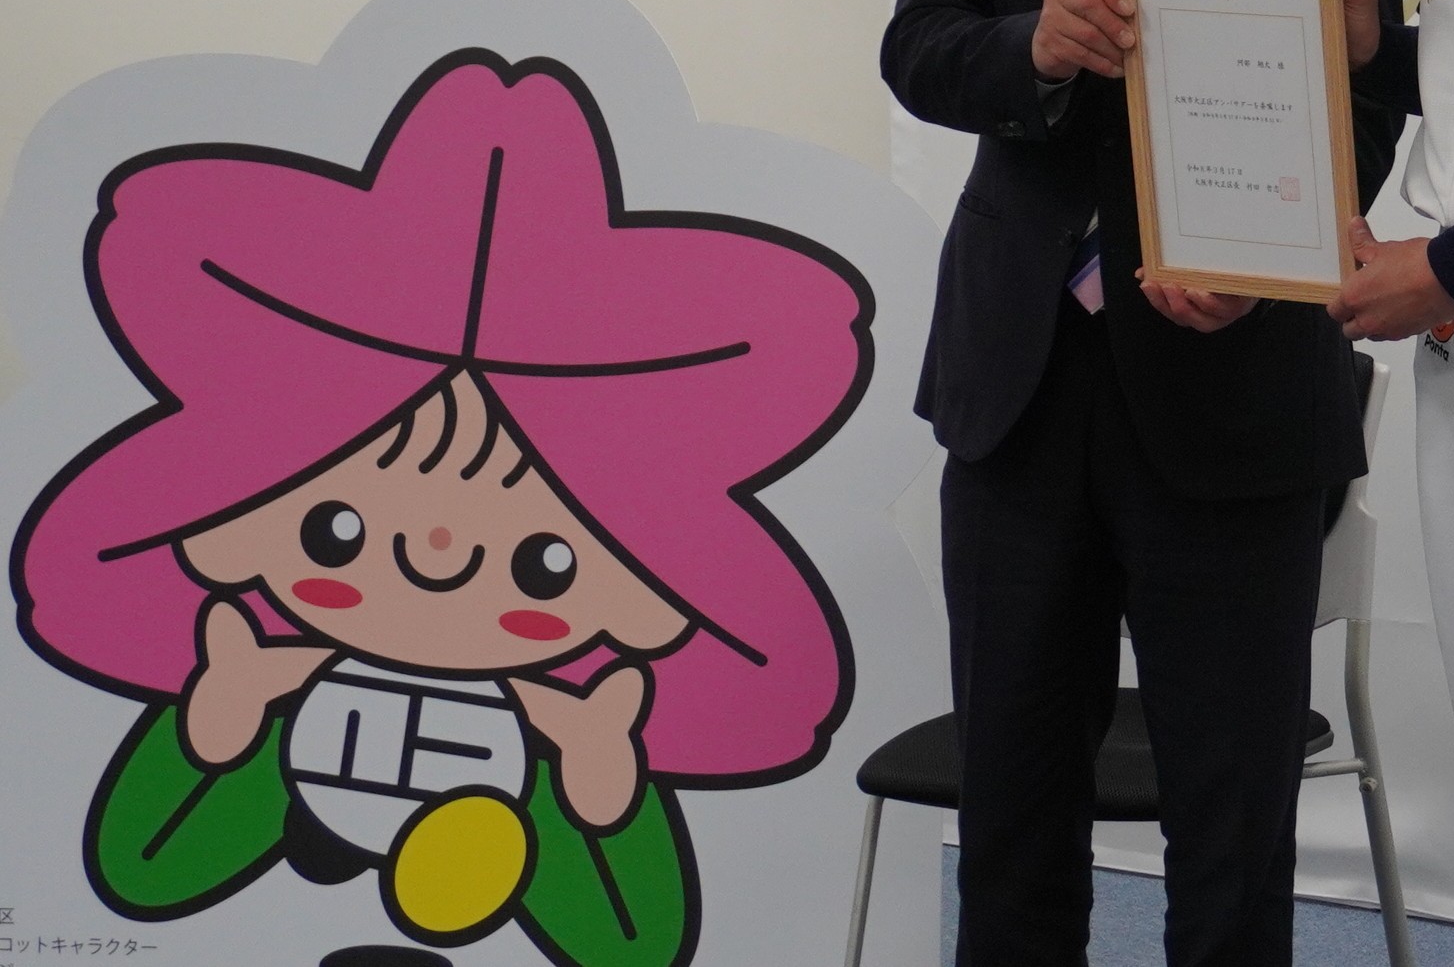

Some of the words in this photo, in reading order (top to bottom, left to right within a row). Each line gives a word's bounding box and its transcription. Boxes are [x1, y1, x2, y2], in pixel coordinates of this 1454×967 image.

[1424, 333, 1450, 362] Ponta
[0, 936, 158, 956] コットキャラクター
